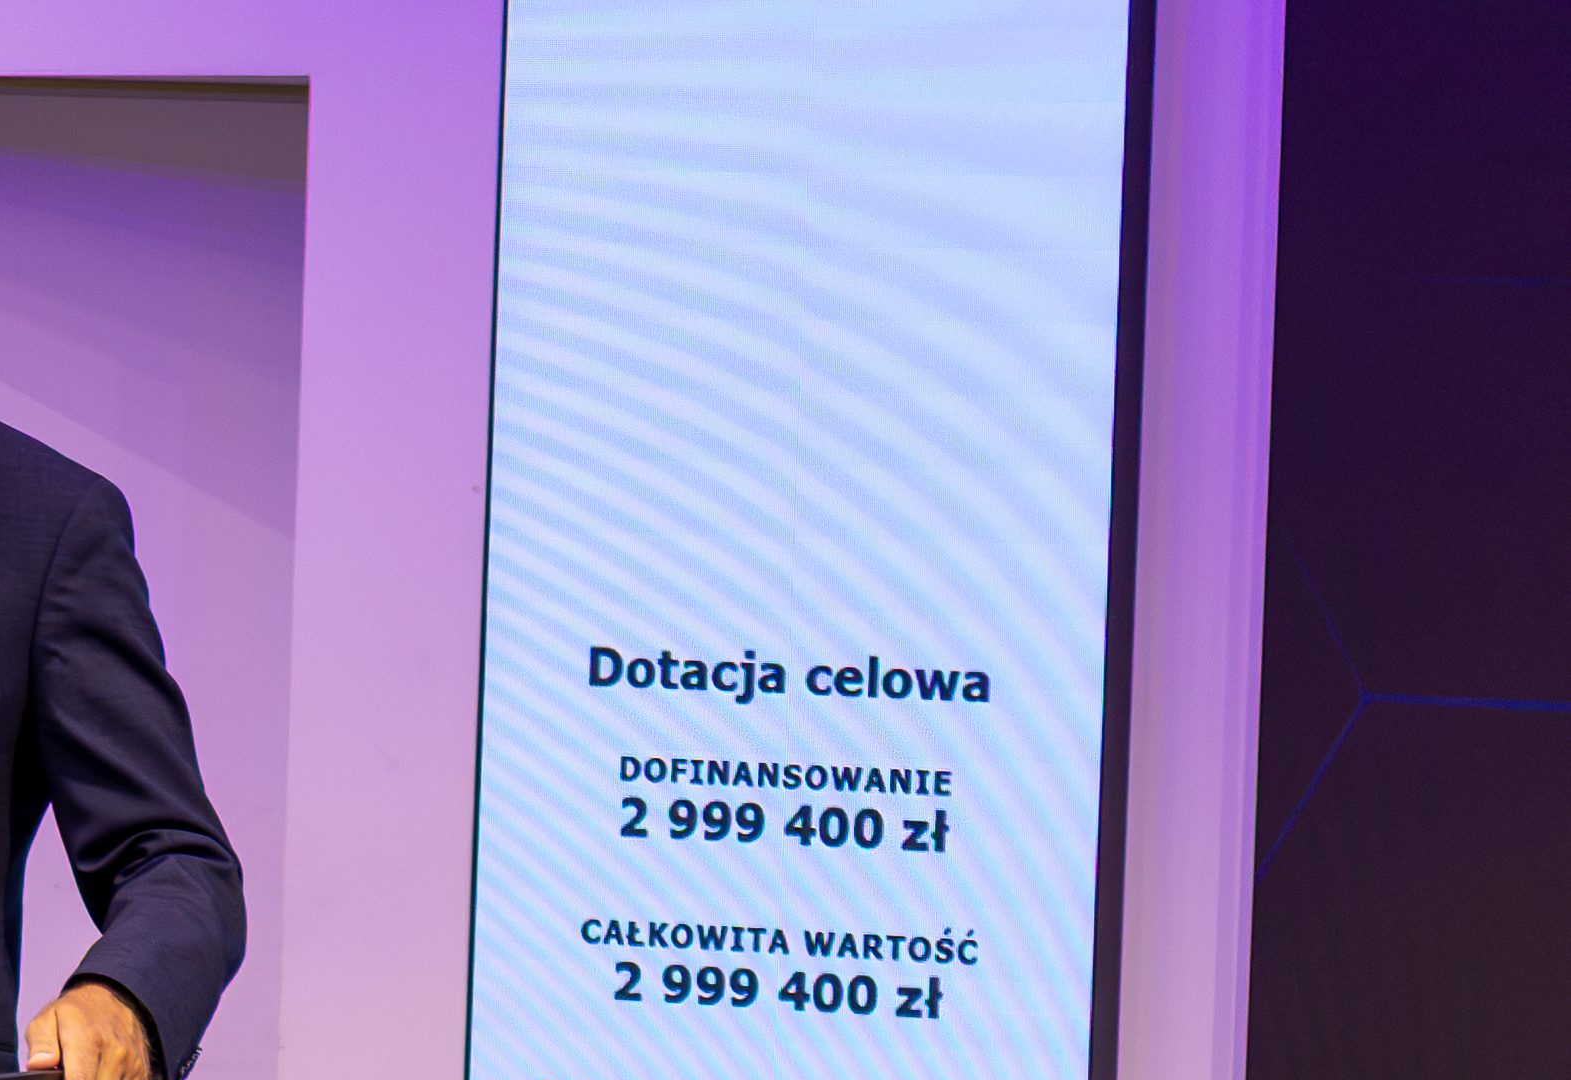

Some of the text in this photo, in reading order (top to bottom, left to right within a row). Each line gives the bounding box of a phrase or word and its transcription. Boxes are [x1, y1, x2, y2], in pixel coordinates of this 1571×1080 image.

[588, 646, 992, 704] Dotacja celowa
[619, 756, 953, 796] DOFINANSOWANIE
[619, 796, 950, 853] 2 999 400 zł
[580, 919, 979, 965] CAŁKOWITA WARTOŚĆ
[613, 961, 943, 1019] 2 999 400 zł
